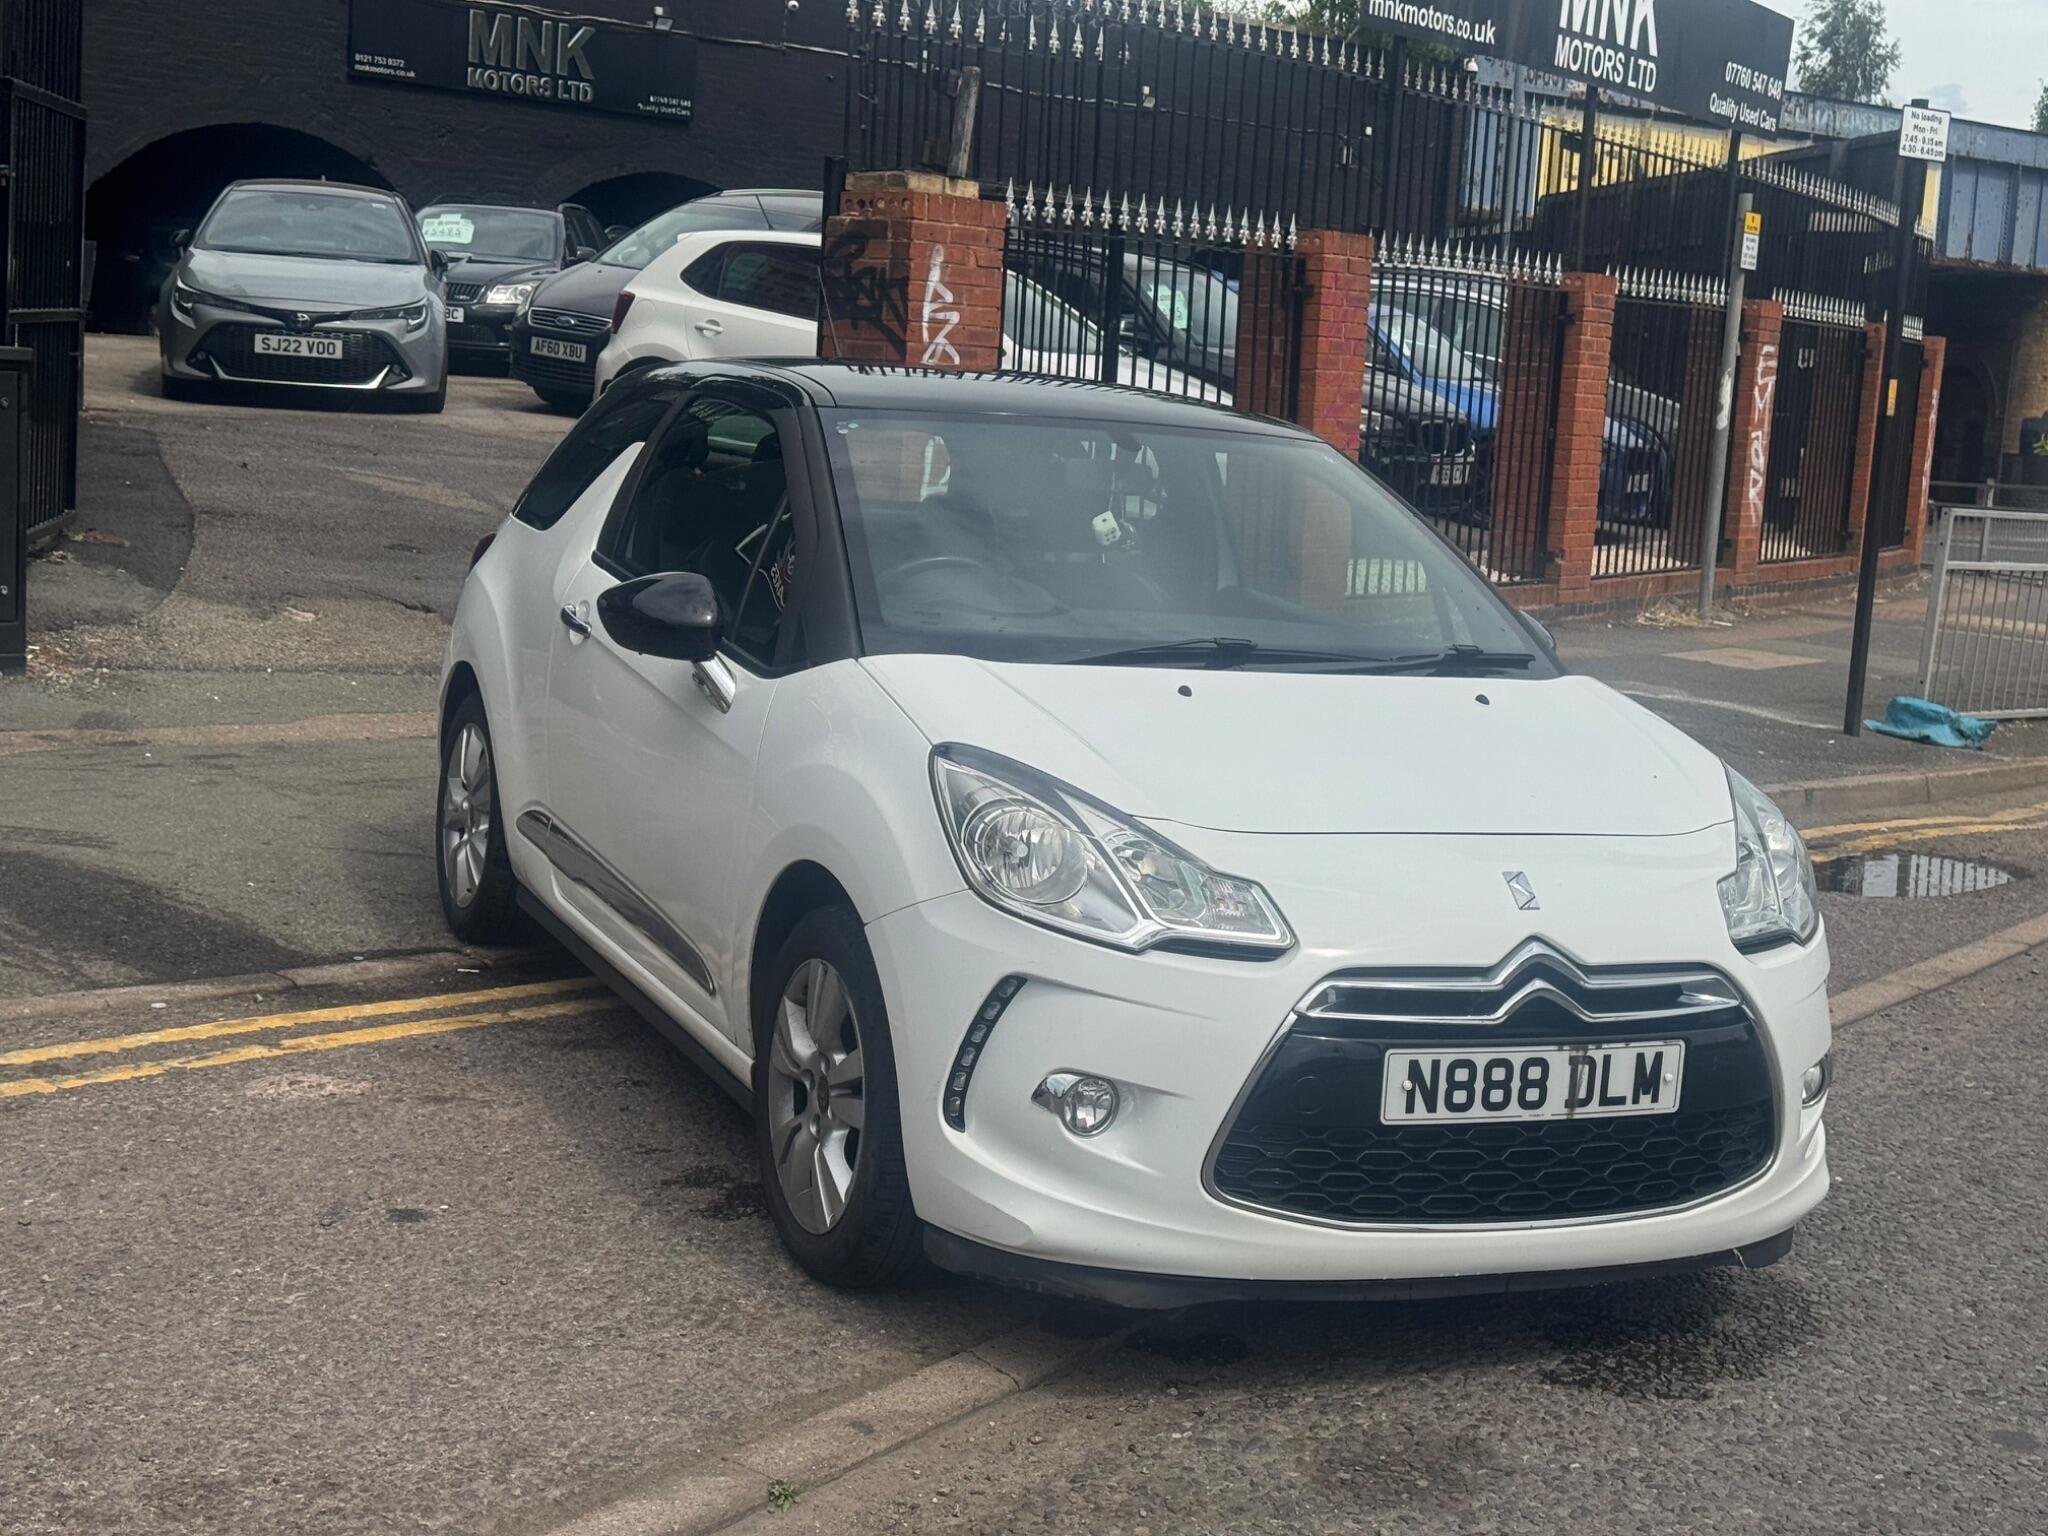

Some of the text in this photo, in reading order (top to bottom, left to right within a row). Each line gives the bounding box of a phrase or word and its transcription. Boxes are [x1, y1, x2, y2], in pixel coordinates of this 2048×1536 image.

[1368, 0, 1496, 45] mnkmotors.co.uk
[355, 53, 372, 63] 0121
[468, 9, 596, 80] MNK
[1554, 34, 1625, 84] MOTORS
[1627, 56, 1657, 93] LTD
[467, 66, 594, 103] MOTORS LTD
[1725, 61, 1783, 100] 07760 547 648
[1709, 92, 1739, 123] Quality
[1739, 102, 1760, 126] Used
[1760, 109, 1777, 132] Cars
[1911, 110, 1943, 125] No loading
[1912, 124, 1926, 133] Mon
[1929, 126, 1938, 135] Fri
[261, 337, 336, 355] SJ22 VOO
[534, 339, 583, 359] AF60 XBU
[1404, 1051, 1664, 1114] N888 DLM
